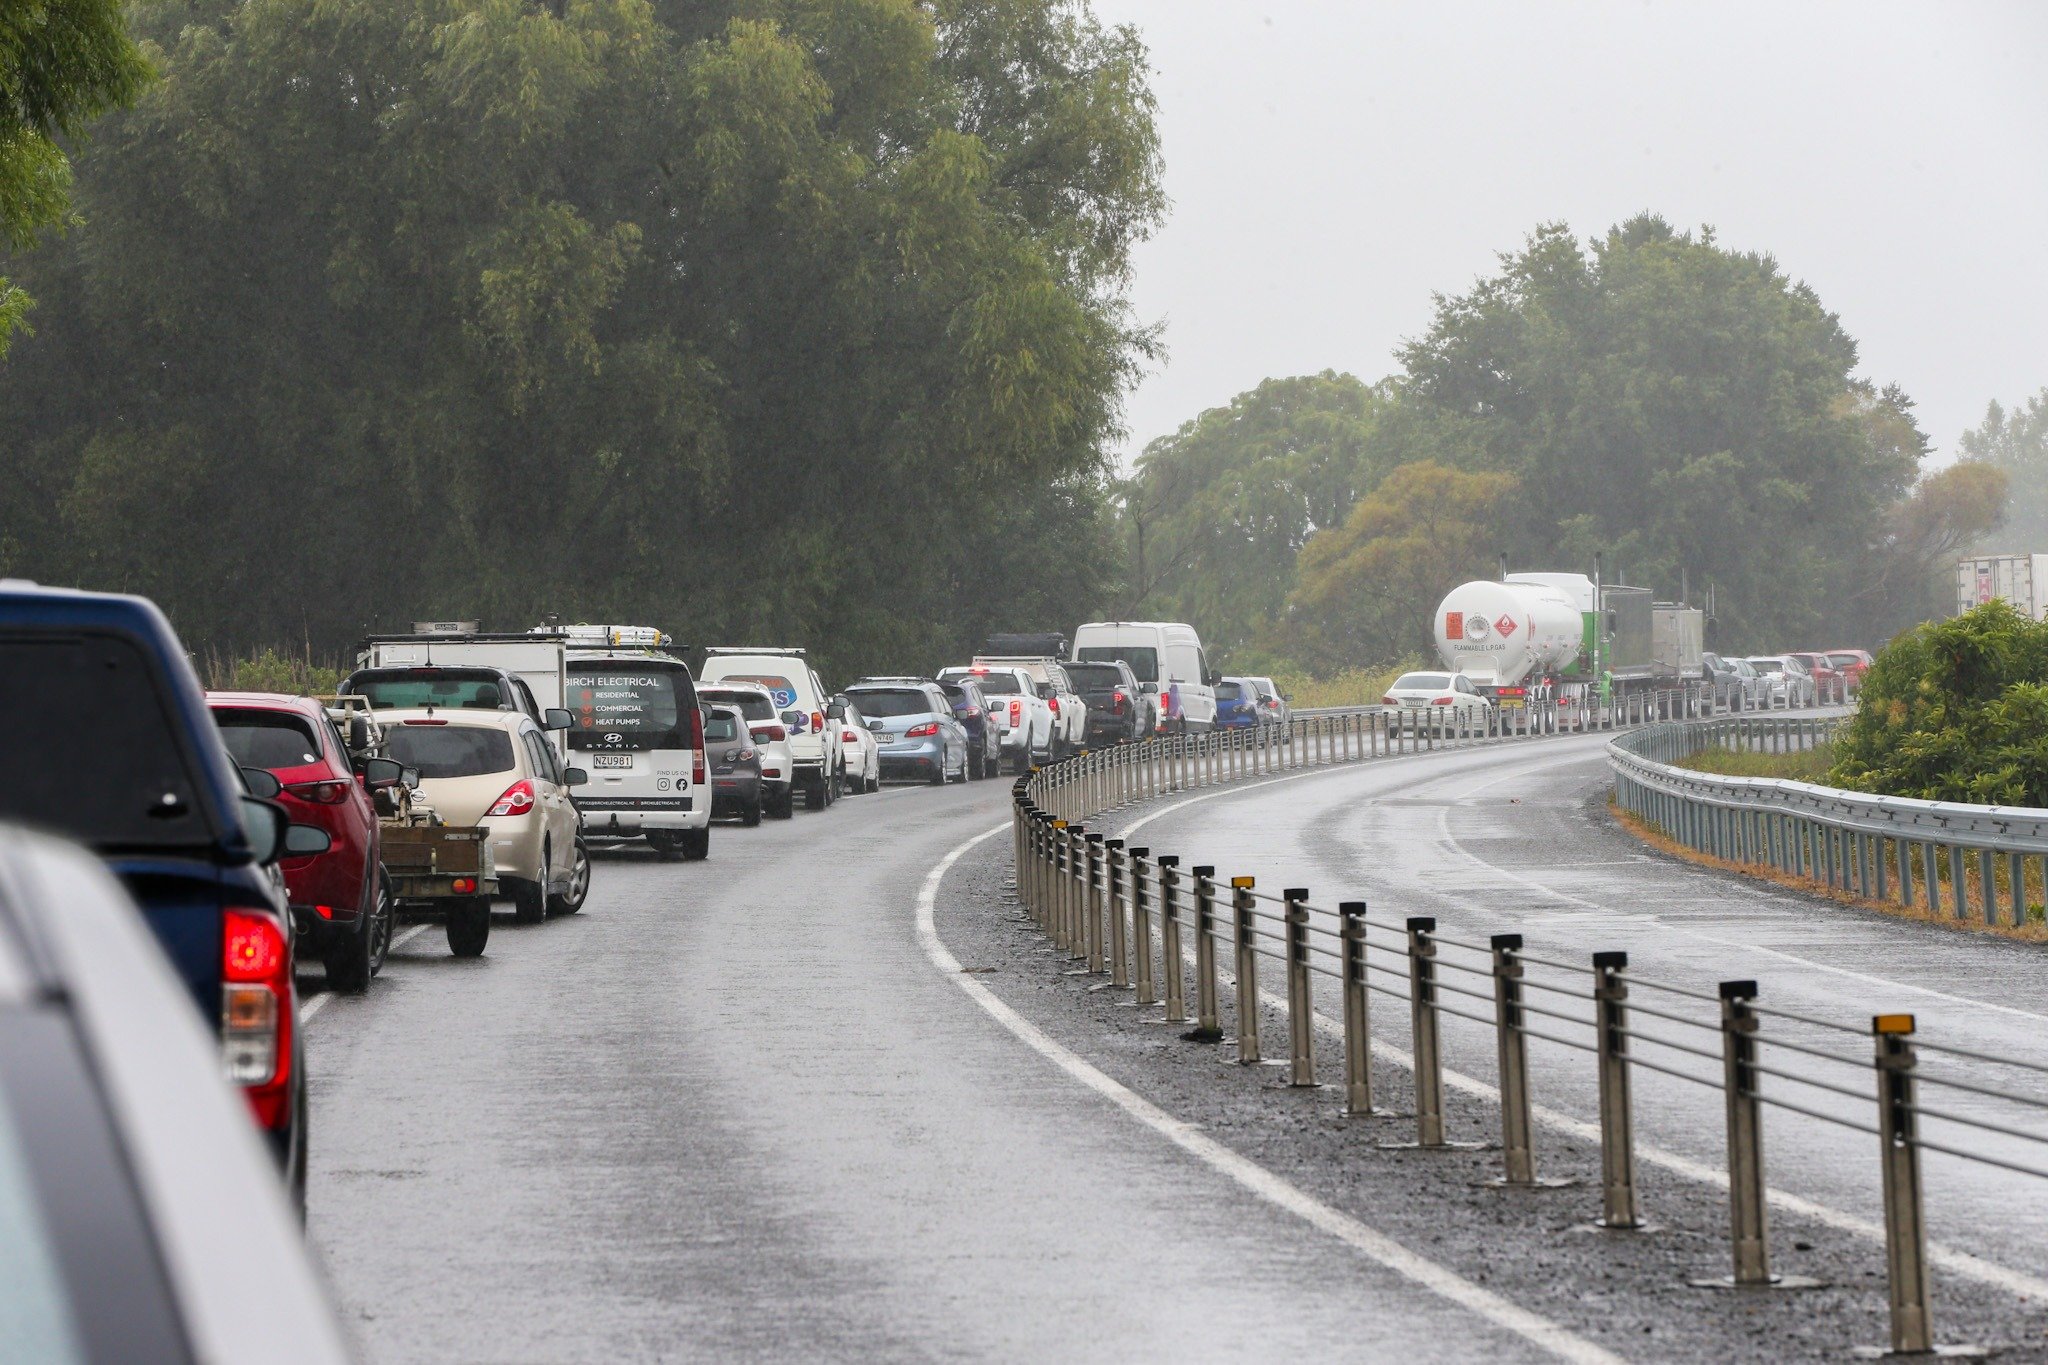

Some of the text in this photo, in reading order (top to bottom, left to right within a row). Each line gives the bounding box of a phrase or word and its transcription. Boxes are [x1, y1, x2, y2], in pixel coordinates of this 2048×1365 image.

[565, 677, 659, 686] BIRCH ELECTRICAL
[595, 691, 639, 699] RESIDENTIAL
[595, 756, 630, 766] NZU981
